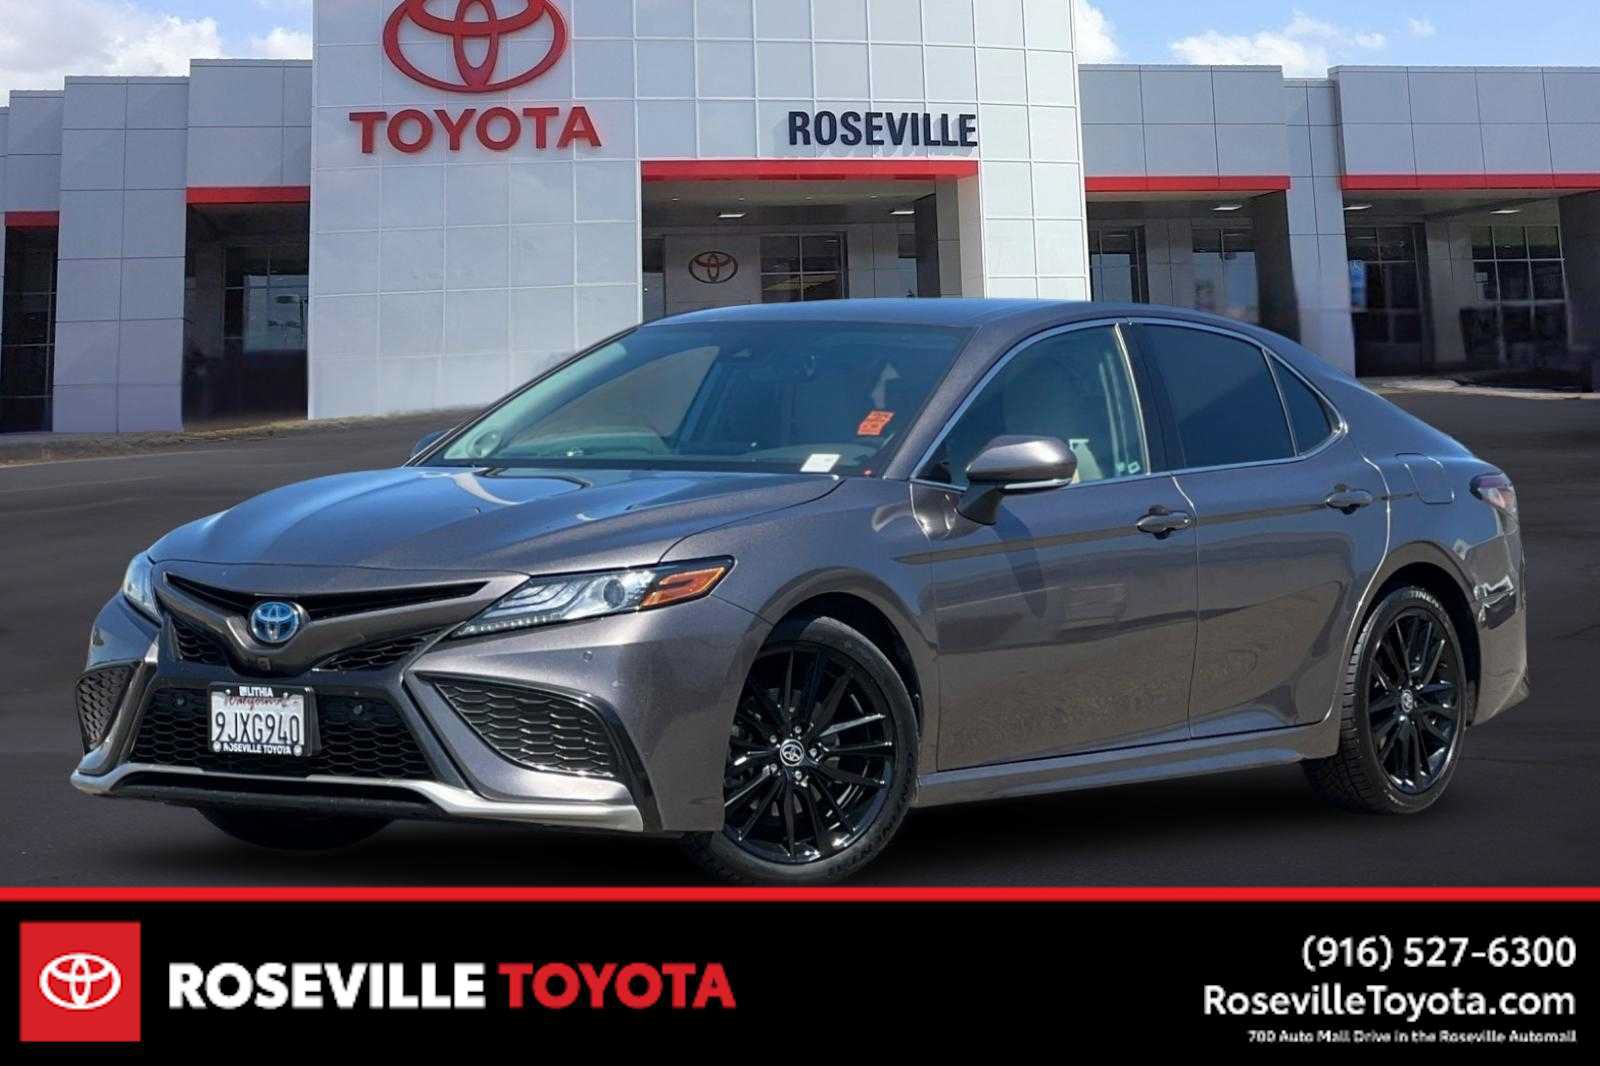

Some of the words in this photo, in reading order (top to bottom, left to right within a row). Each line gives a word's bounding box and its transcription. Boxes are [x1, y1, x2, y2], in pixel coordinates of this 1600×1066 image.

[349, 106, 602, 154] TOYOTA
[788, 110, 978, 147] ROSEVILLE
[215, 711, 299, 744] 9JXG940
[263, 743, 292, 755] TOYOTA
